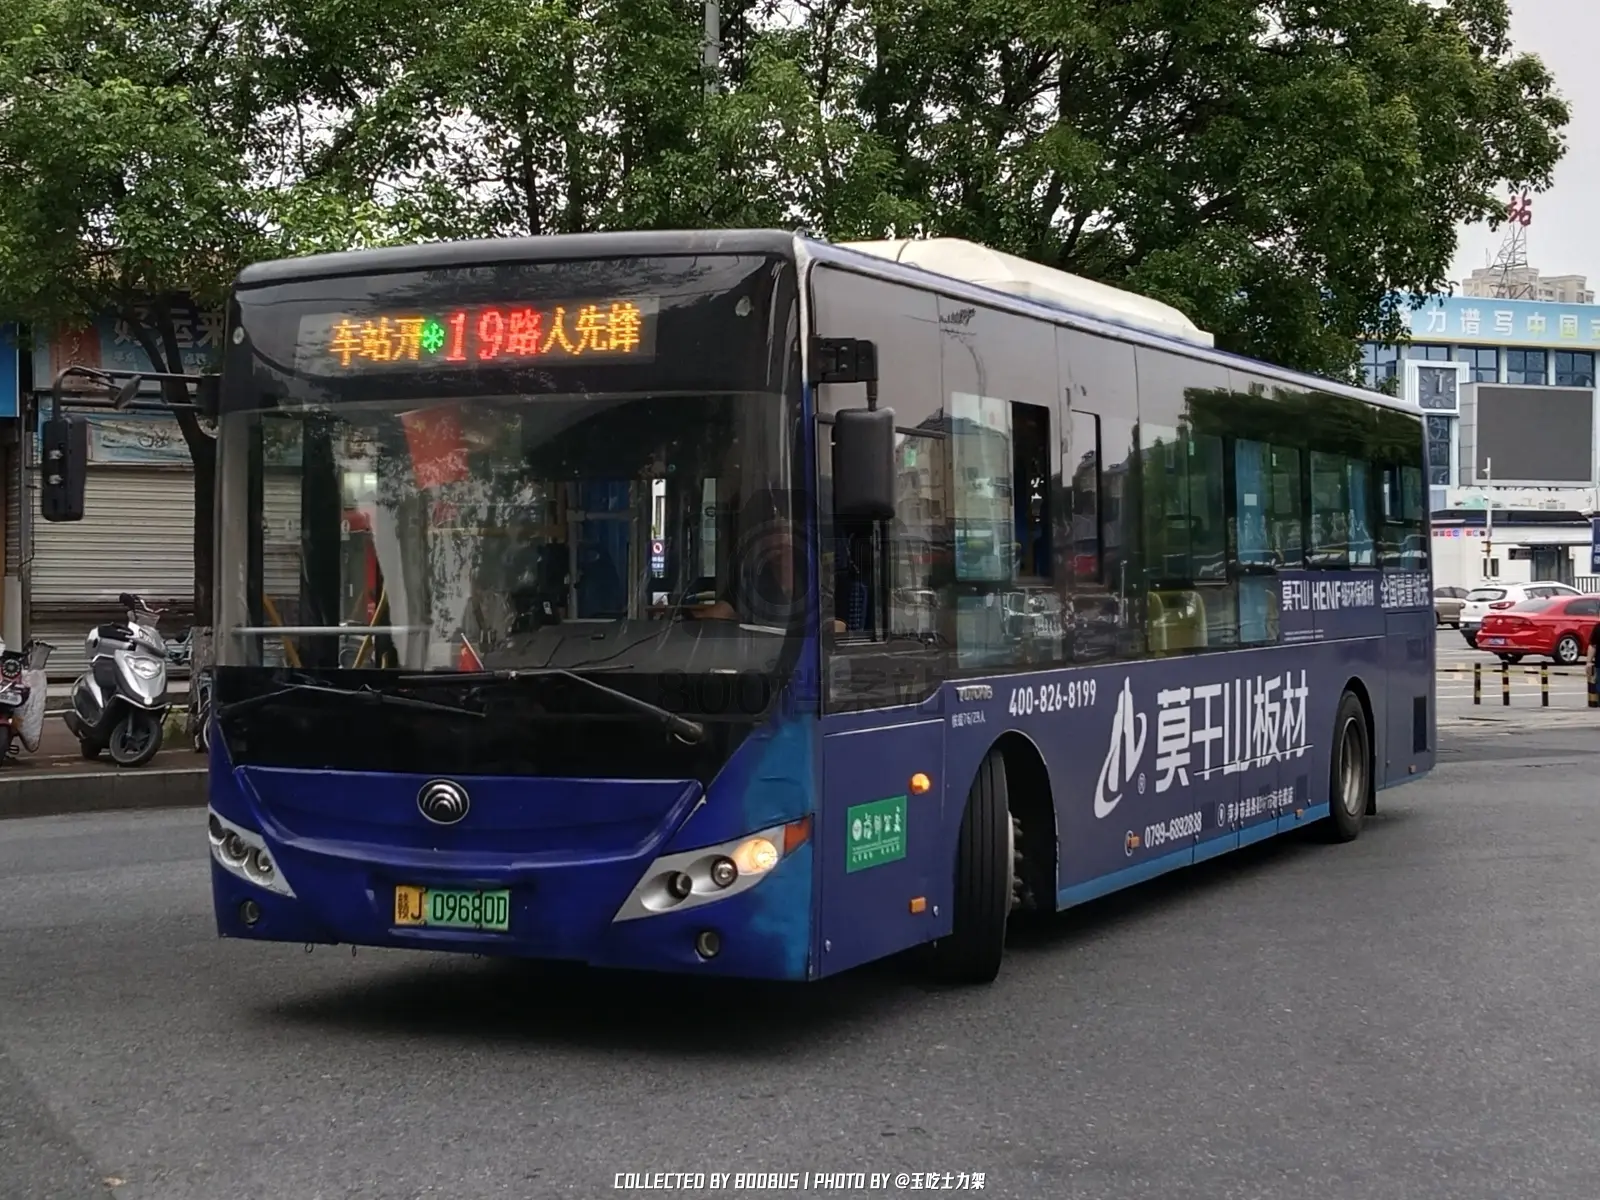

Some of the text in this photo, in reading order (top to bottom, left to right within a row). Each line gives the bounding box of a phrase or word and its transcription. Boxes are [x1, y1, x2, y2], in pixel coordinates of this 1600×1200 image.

[1008, 679, 1097, 717] 400-826-8199
[1155, 669, 1309, 793] 莫干山板材
